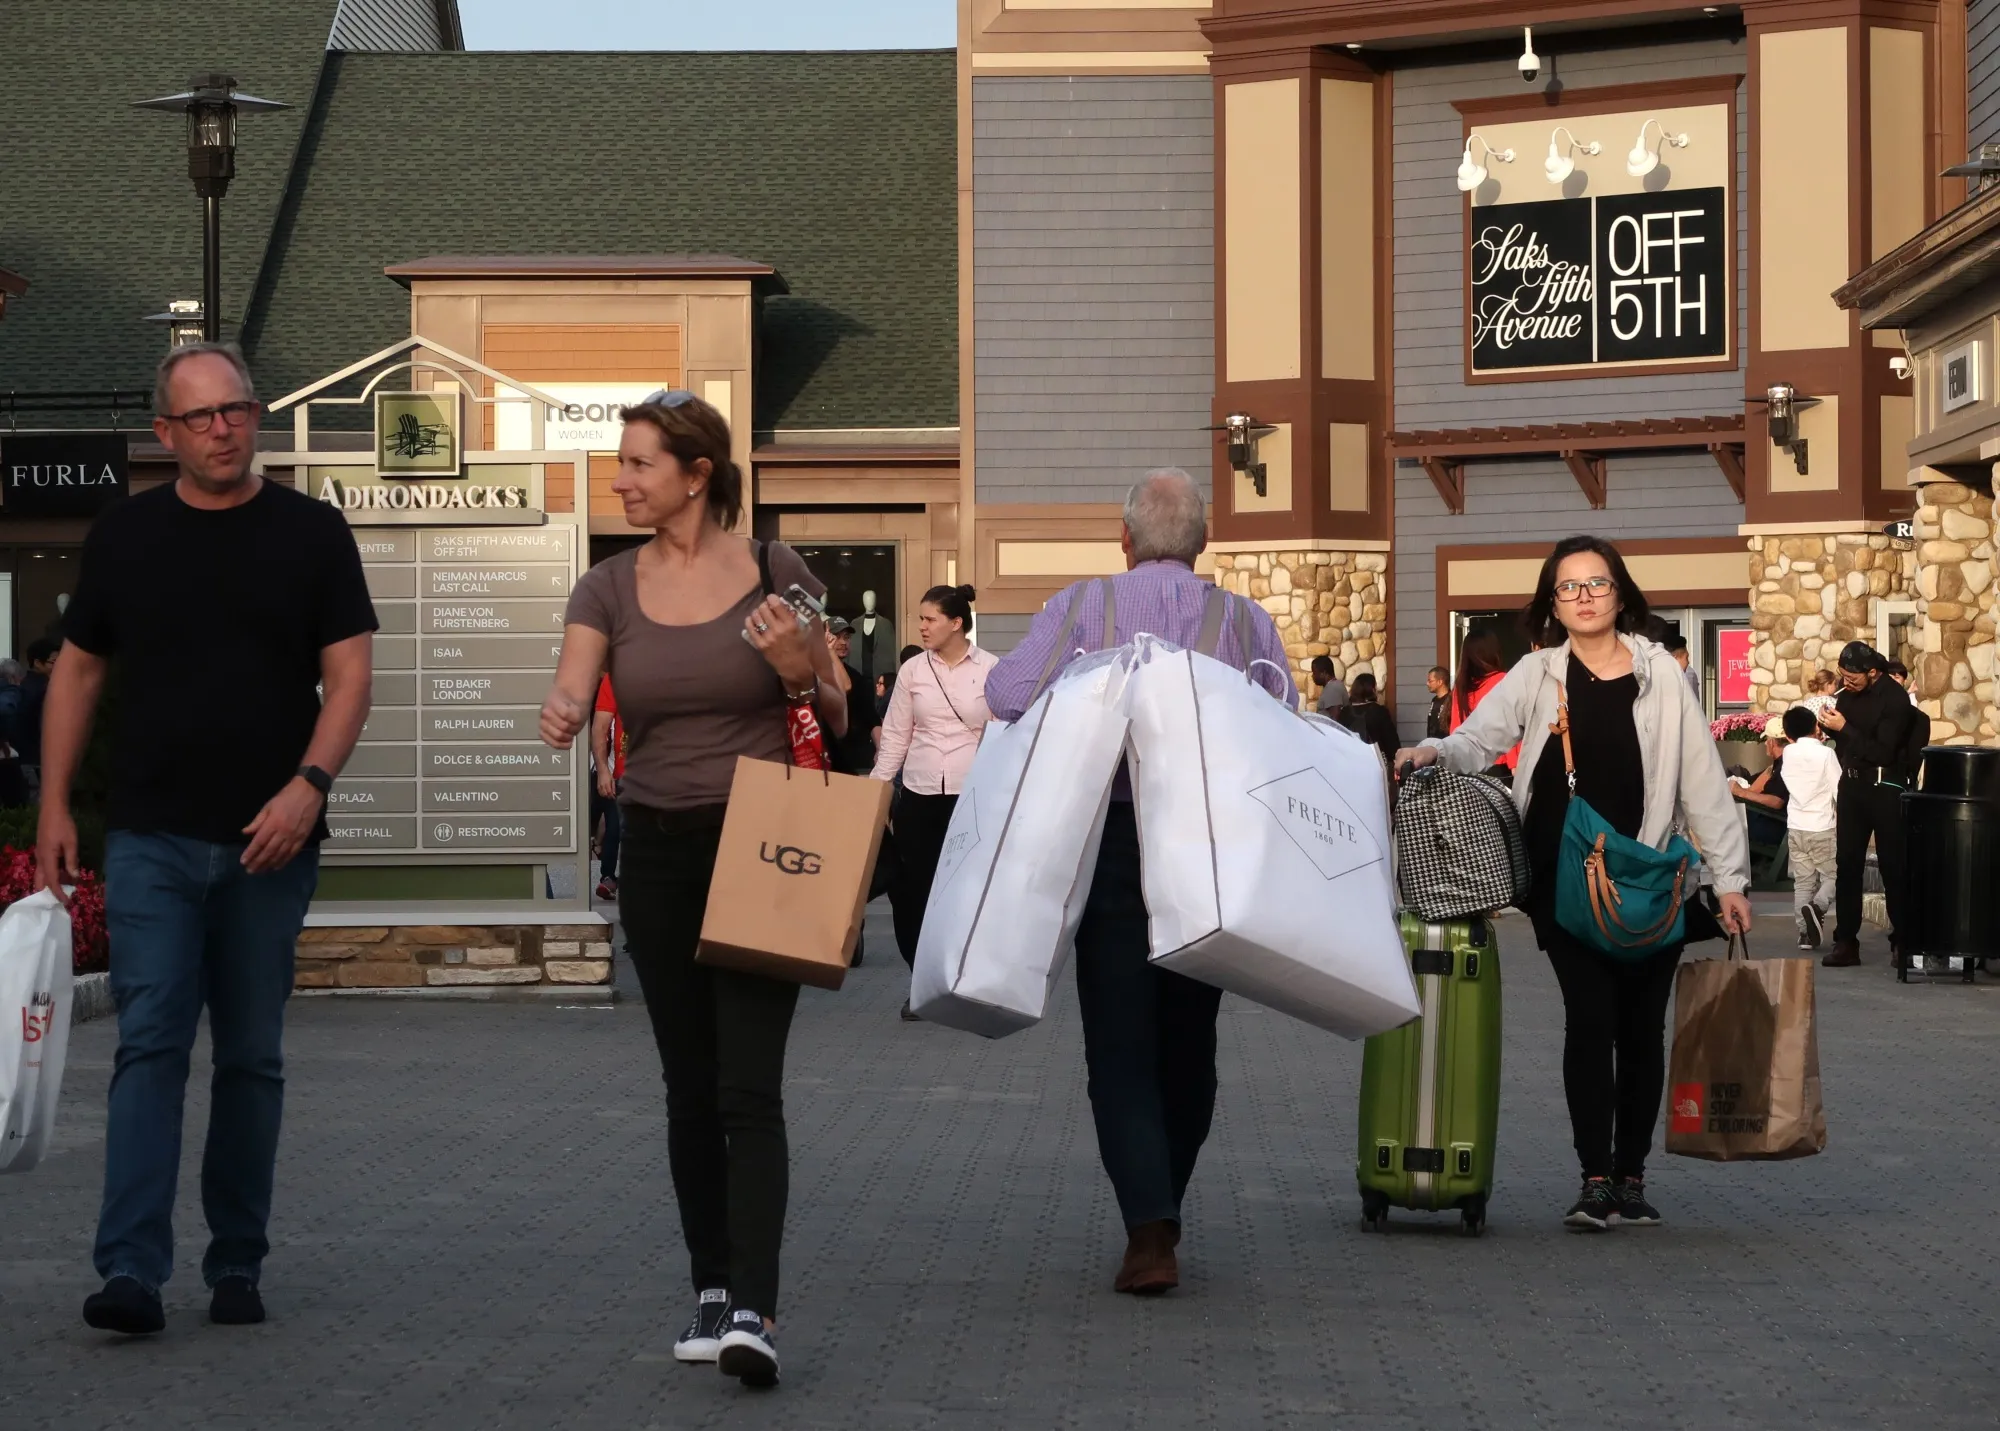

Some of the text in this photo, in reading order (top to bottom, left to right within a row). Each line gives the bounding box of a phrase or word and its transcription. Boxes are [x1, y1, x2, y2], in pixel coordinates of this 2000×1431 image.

[1608, 209, 1705, 277] OFF
[1471, 223, 1549, 285] Saks
[1610, 274, 1706, 341] 5TH
[1471, 294, 1582, 350] Avenue
[558, 429, 603, 440] WOMEN
[11, 463, 118, 487] FURLA
[319, 475, 520, 510] ADIRONDACKS
[433, 535, 547, 546] SAKS FIFTH AVENUE
[357, 543, 395, 553] ENTER
[433, 546, 478, 557] OFF 5TH
[433, 571, 527, 581] NEIMAN MARCUS
[433, 582, 490, 593] LAST CALL
[433, 607, 494, 617] DIANE VON
[433, 618, 510, 628] FURSTENBERG
[433, 648, 463, 658] ISAIA
[432, 679, 491, 689] TED BAKER
[432, 690, 482, 700] LONDON
[434, 719, 514, 729] RALPH LAUREN
[434, 755, 540, 765] DOLCE & GABBANA
[339, 792, 375, 803] PLAZA
[433, 791, 499, 802] VALENTINO
[1287, 795, 1357, 844] FRETTE
[329, 827, 393, 838] ARKET HALL
[458, 826, 526, 837] RESTROOMS
[1314, 830, 1334, 845] 1860
[759, 841, 822, 875] UGG
[1710, 1100, 1736, 1116] STOP
